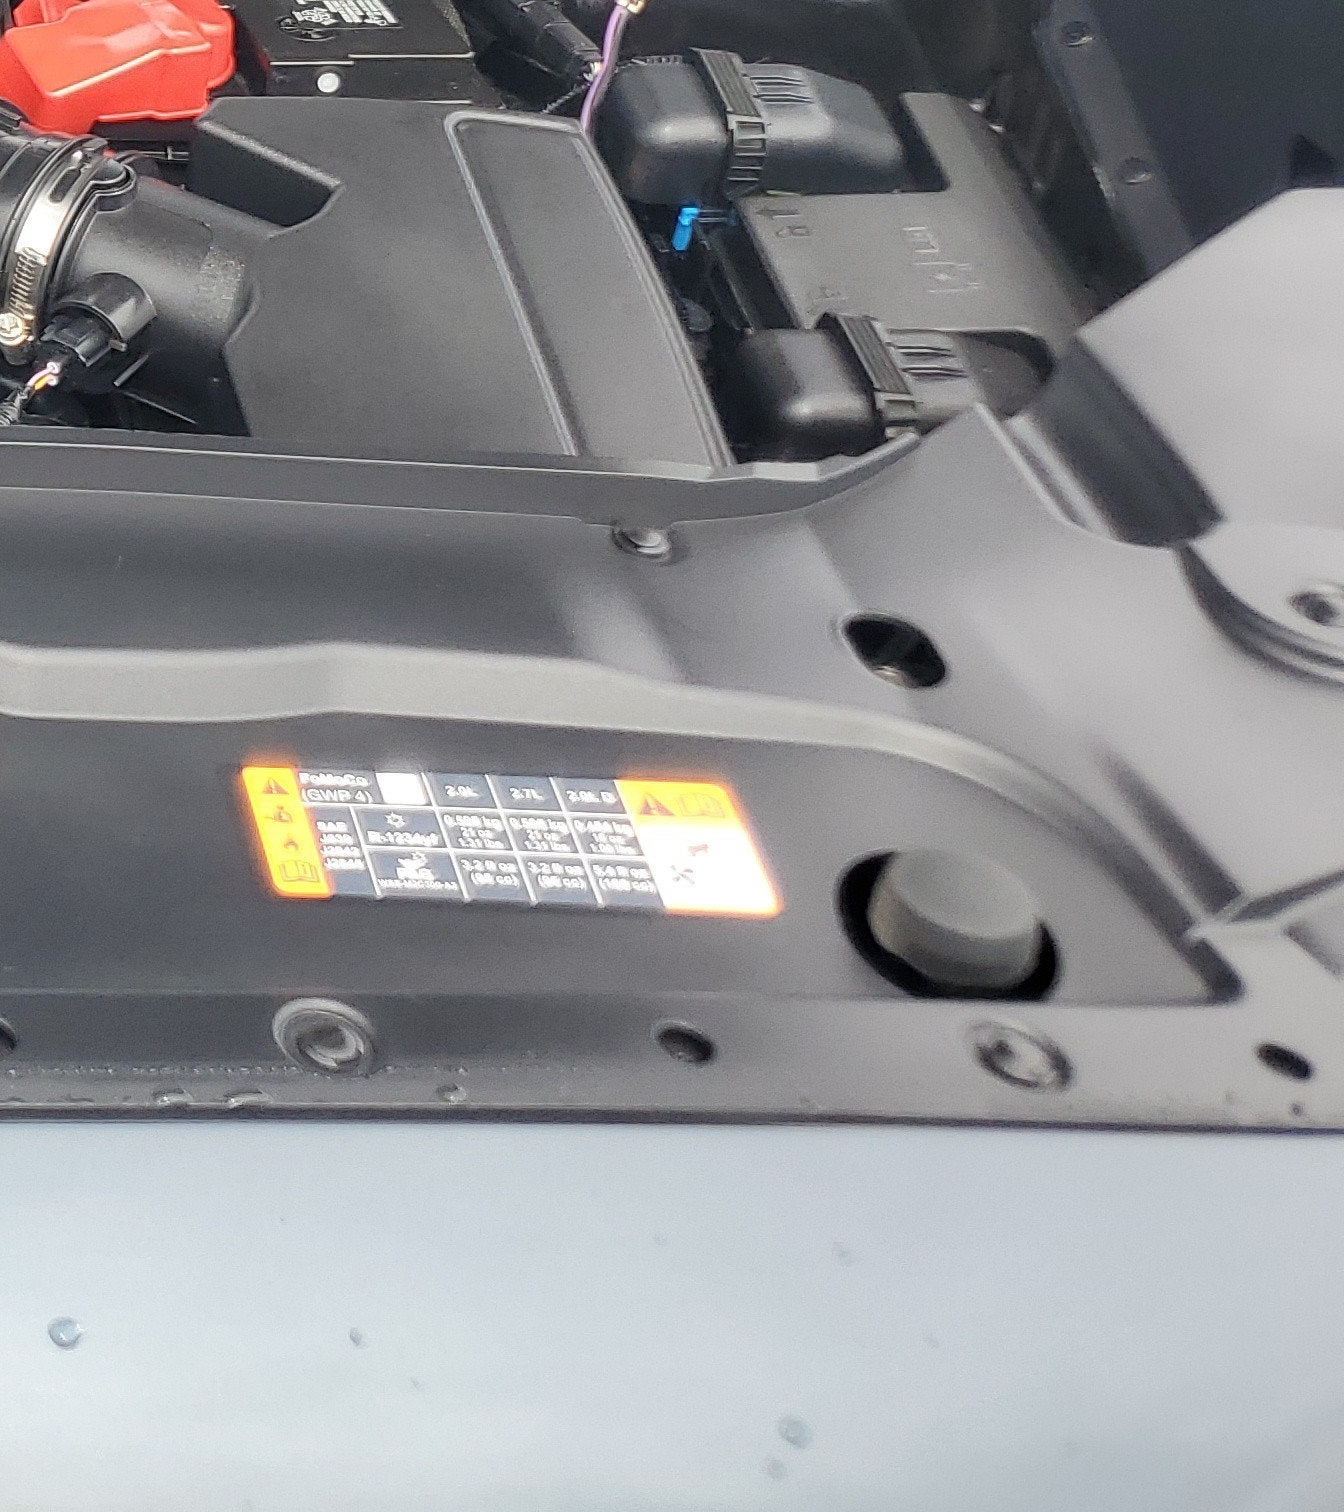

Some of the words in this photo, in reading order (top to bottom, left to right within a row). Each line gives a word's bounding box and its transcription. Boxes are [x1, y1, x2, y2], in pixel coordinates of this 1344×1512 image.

[298, 772, 369, 787] FoMoCo
[301, 788, 351, 803] (GWP
[355, 790, 374, 804] 4)
[445, 785, 480, 798] 2.0L
[509, 787, 545, 801] 2.7L
[482, 815, 504, 832] kg
[547, 818, 570, 835] kg
[366, 830, 439, 847] R-1234yf
[460, 859, 483, 872] 3.2
[527, 861, 551, 875] 3.2
